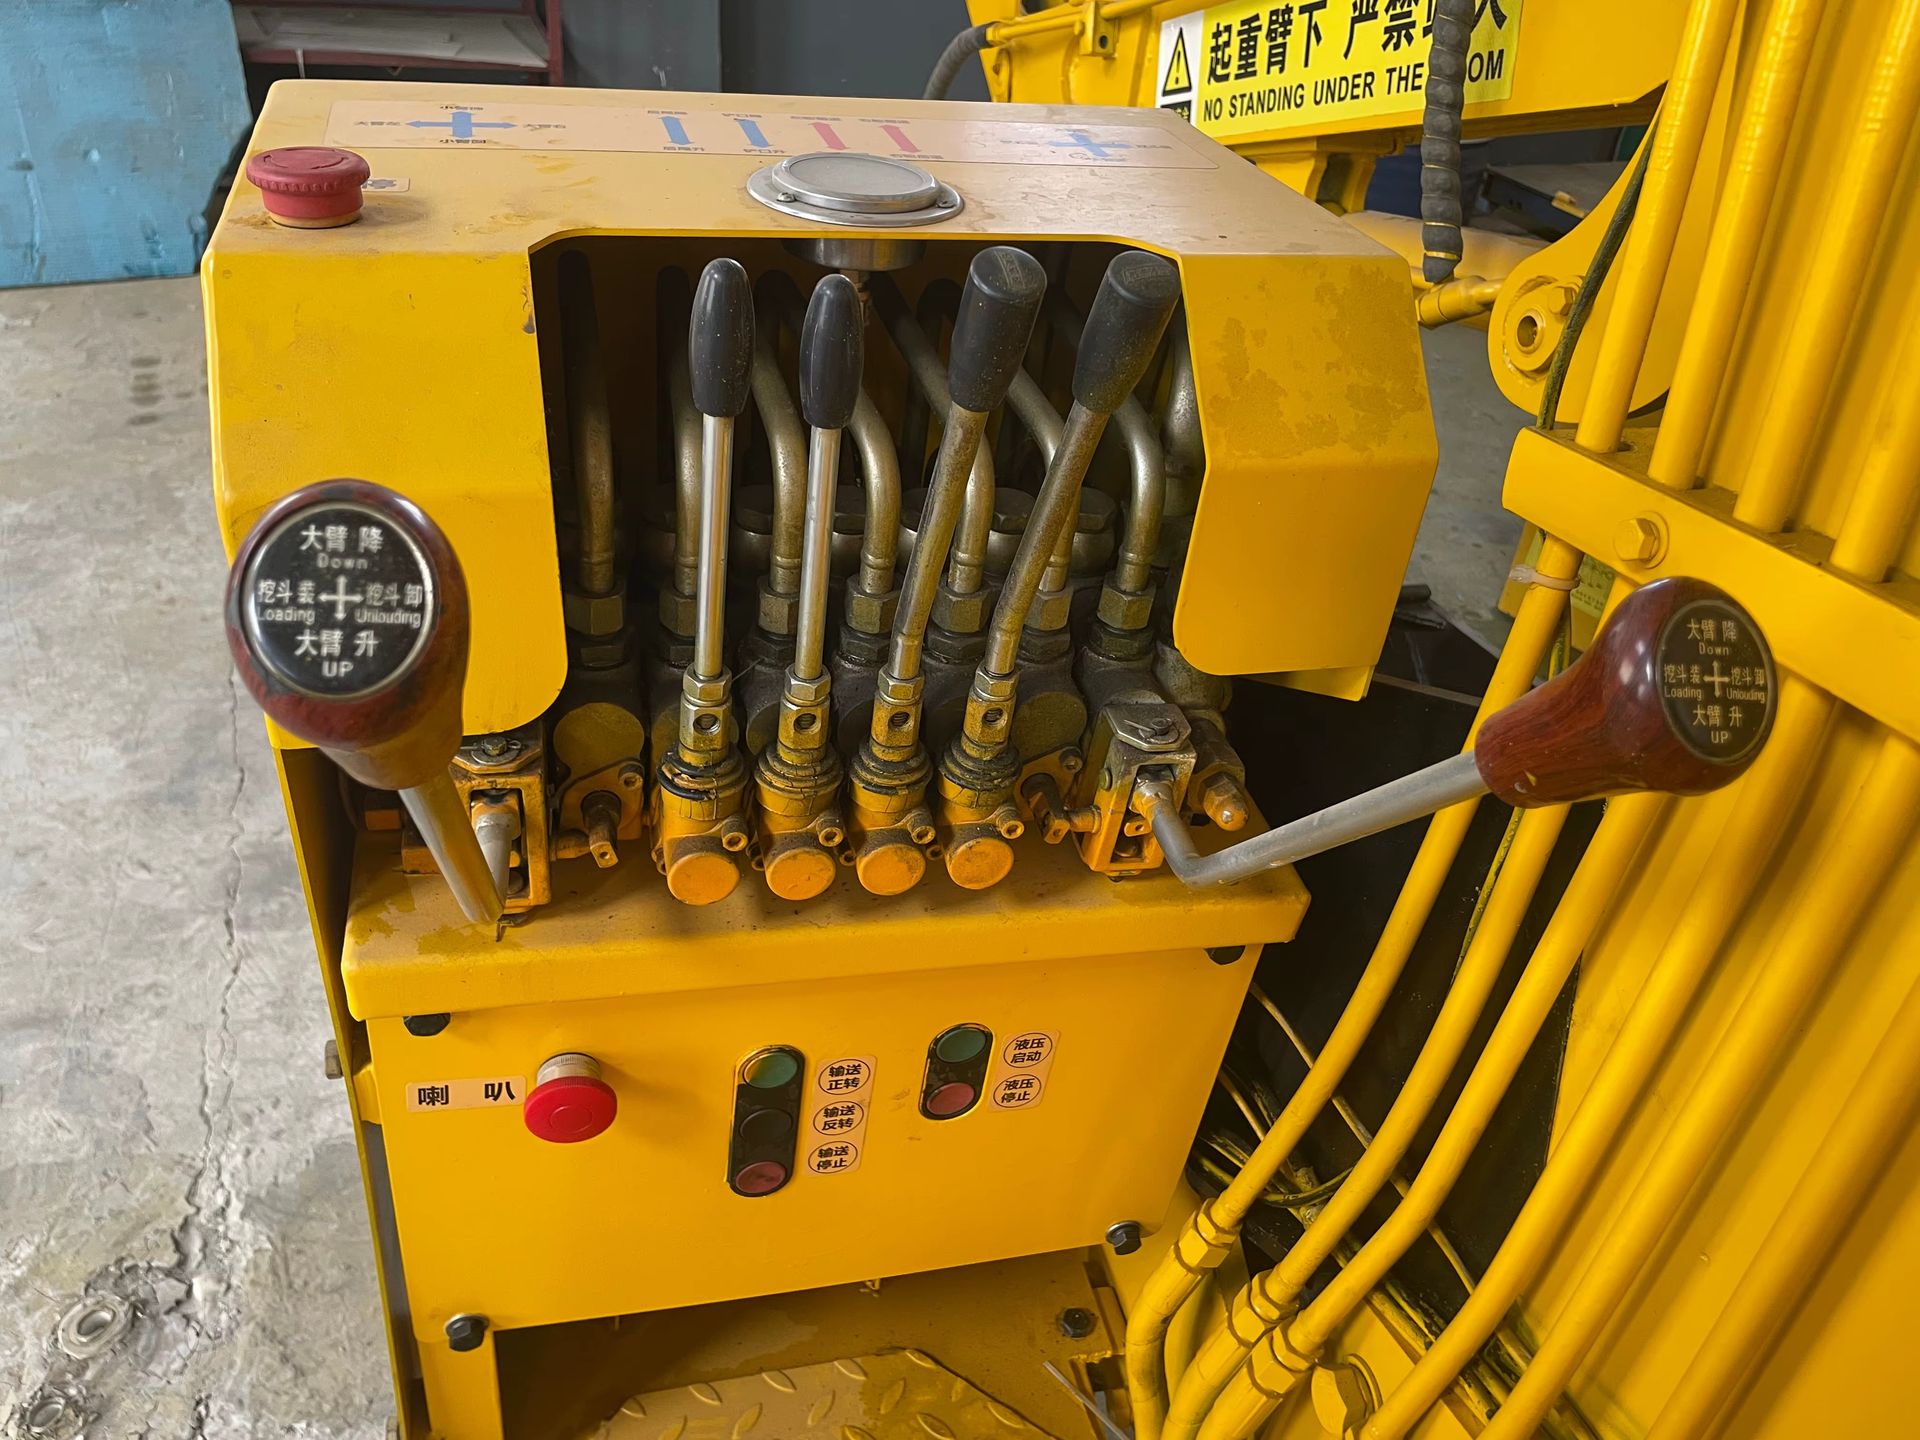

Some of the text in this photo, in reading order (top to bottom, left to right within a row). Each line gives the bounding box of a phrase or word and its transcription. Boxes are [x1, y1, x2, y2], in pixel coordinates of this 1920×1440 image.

[1207, 0, 1327, 85] 起重臂下
[1203, 97, 1223, 122] NO
[1229, 83, 1305, 119] STANDING
[1314, 71, 1375, 106] UNDER
[1386, 62, 1425, 95] THE
[1467, 48, 1505, 83] OM
[316, 553, 368, 569] Down
[257, 607, 316, 625] Loading
[1699, 641, 1729, 655] Down
[321, 660, 354, 678] UP
[1664, 686, 1702, 700] Loading
[1710, 730, 1729, 744] UP
[1013, 1036, 1046, 1051] 液压
[1010, 1050, 1042, 1064] 启动
[828, 1062, 862, 1078] 输送
[826, 1077, 860, 1091] 正转
[1003, 1076, 1036, 1091] 液压
[1000, 1090, 1031, 1104] 停止
[823, 1104, 856, 1118] 输送
[821, 1117, 854, 1131] 反转
[817, 1145, 850, 1159] 输送
[816, 1158, 848, 1171] 停止
